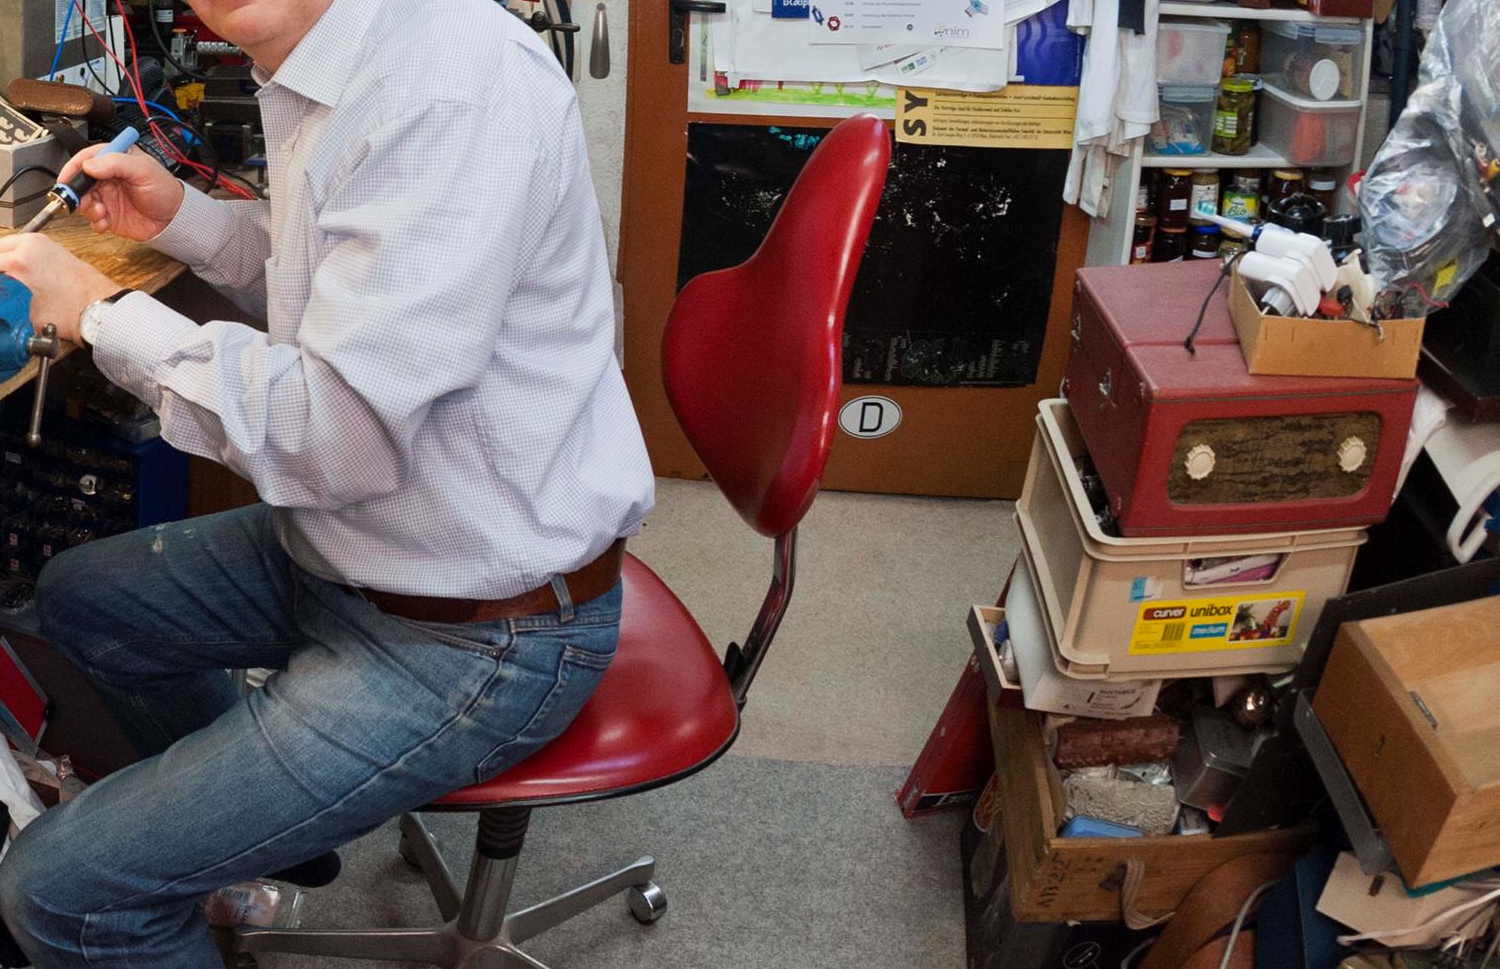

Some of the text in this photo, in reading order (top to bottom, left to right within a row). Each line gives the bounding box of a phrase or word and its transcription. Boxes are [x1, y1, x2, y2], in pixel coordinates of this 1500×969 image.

[903, 90, 928, 137] SY
[859, 402, 884, 432] D
[1152, 603, 1234, 619] curver unibox
